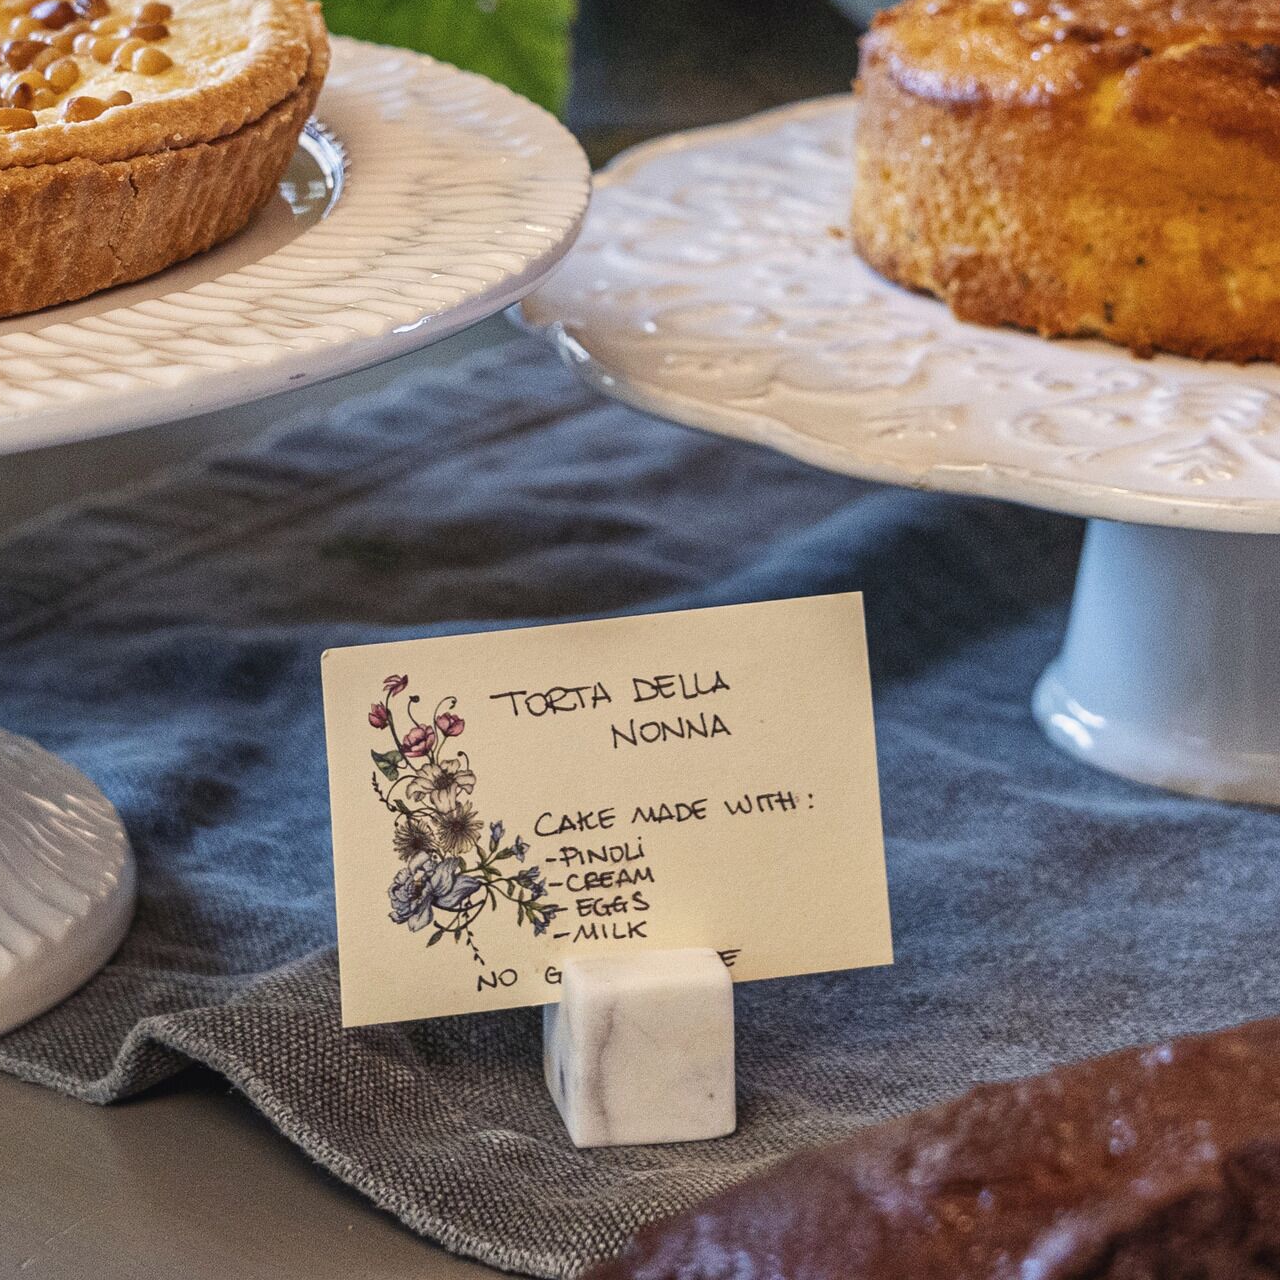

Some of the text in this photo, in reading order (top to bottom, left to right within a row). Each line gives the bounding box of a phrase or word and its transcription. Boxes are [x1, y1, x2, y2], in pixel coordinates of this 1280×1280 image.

[489, 670, 731, 717] TORTA DELLA
[610, 712, 732, 749] NONNA
[533, 807, 617, 837] CAKE
[631, 798, 708, 824] MADE
[477, 968, 518, 992] NO
